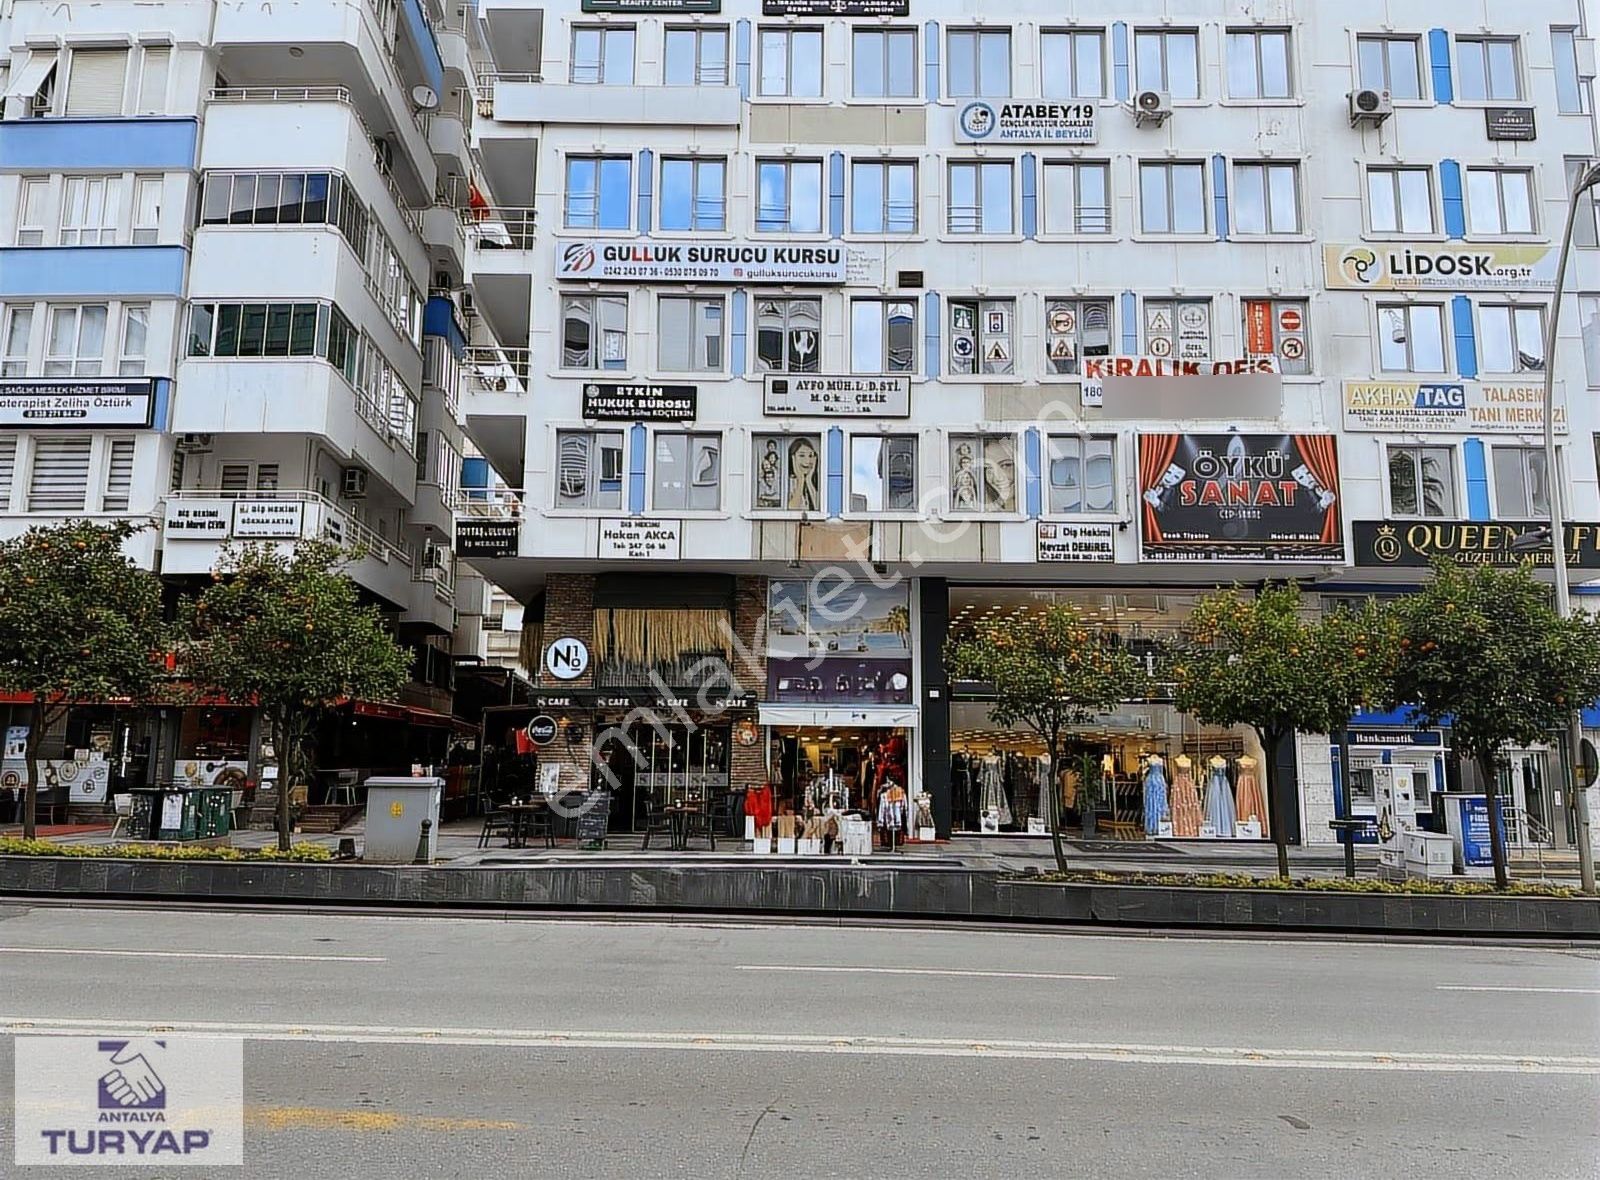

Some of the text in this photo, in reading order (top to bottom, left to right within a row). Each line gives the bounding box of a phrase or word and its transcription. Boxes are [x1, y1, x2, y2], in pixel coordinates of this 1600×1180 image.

[1000, 104, 1094, 119] ATABEY19
[1000, 130, 1042, 138] ANTALYA
[1044, 129, 1053, 138] İL
[773, 248, 840, 264] KURSU
[603, 266, 623, 275] 0242
[623, 266, 637, 275] 243
[746, 268, 838, 279] gulluksurucukursu
[616, 384, 663, 397] ETKİN
[796, 380, 824, 391] AYFO
[54, 399, 90, 408] Zeliha
[587, 396, 691, 409] HUKUK BÜROSU
[855, 392, 887, 404] ÇELİK
[597, 408, 629, 416] Mustafa
[1469, 404, 1566, 422] TANI MERKZİ
[1193, 451, 1284, 478] ÖYKÜ
[1180, 480, 1298, 506] SANAT
[603, 530, 640, 540] Hakan
[1063, 527, 1111, 538] Diş Hekimi
[1039, 541, 1112, 552] Nevzat DEMİREL
[1455, 551, 1520, 564] GÜZELLİK
[547, 698, 570, 706] CAFE
[608, 698, 630, 706] CAFE
[667, 698, 689, 707] CAFE
[726, 699, 747, 708] CAFE
[1356, 733, 1414, 744] Bankamatik
